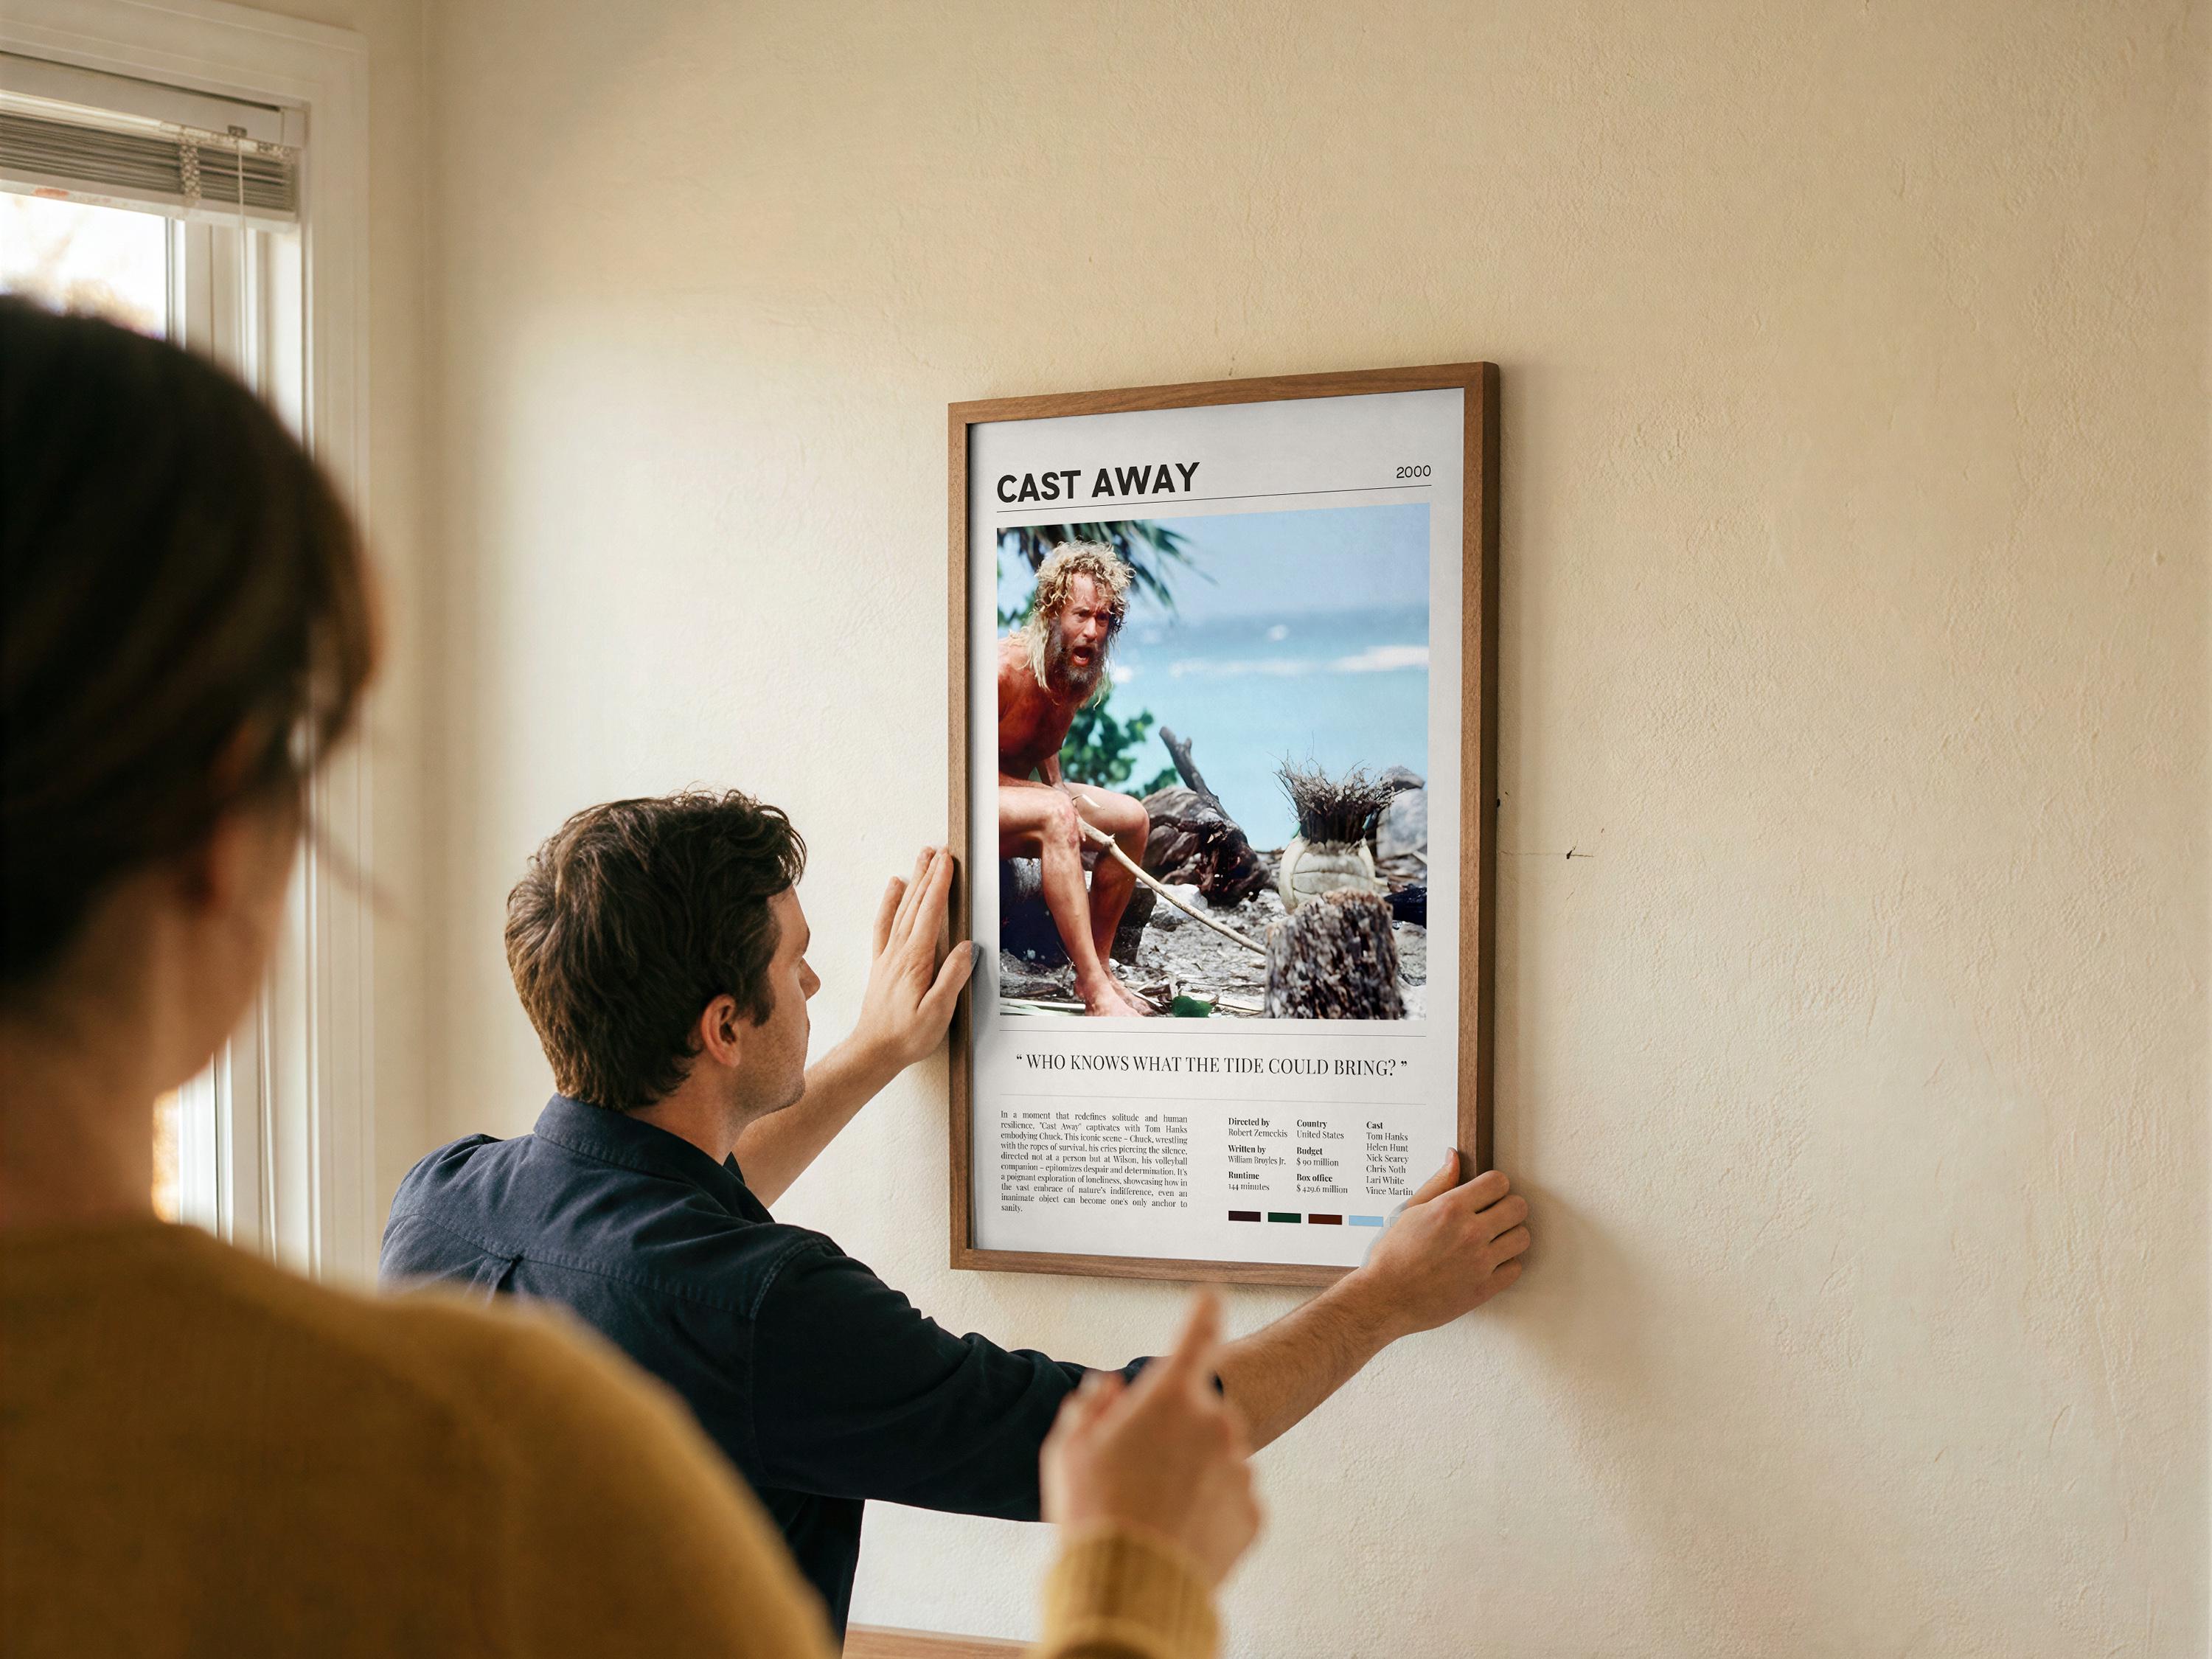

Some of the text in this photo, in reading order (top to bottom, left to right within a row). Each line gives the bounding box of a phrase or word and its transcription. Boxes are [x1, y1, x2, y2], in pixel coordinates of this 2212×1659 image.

[1397, 465, 1431, 479] 2000
[997, 462, 1200, 503] CAST AWAY
[1026, 1054, 1065, 1069] WHO
[1071, 1055, 1129, 1071] KNOWS
[1133, 1057, 1181, 1071] WHAT
[1186, 1057, 1219, 1072] THE
[1224, 1058, 1263, 1073] TIDE
[1269, 1059, 1328, 1074] COULD
[1335, 1060, 1396, 1076] BRING?
[1023, 1112, 1050, 1120] moment
[1056, 1112, 1069, 1120] that
[1075, 1113, 1106, 1121] redefines
[1112, 1113, 1138, 1121] solitude
[1145, 1114, 1158, 1122] and
[1164, 1115, 1187, 1123] human
[1086, 1123, 1120, 1132] captivates
[1124, 1124, 1140, 1132] with
[1144, 1124, 1161, 1133] Tom
[1165, 1125, 1187, 1133] Hanks
[1228, 1118, 1270, 1128] Directed by
[1297, 1119, 1327, 1129] Country
[1366, 1121, 1382, 1130] Cast
[1001, 1131, 1038, 1141] embodying
[1064, 1133, 1079, 1141] This
[1080, 1133, 1101, 1141] iconic
[1155, 1135, 1188, 1145] wrestling
[1228, 1128, 1288, 1138] Robert Zemeckis
[1297, 1130, 1344, 1139] United States
[1366, 1132, 1408, 1141] Tom Hanks
[1001, 1141, 1016, 1150] with
[1017, 1142, 1029, 1150] the
[1089, 1144, 1099, 1152] his
[1100, 1144, 1118, 1152] cries
[1119, 1145, 1147, 1155] piercing
[1149, 1146, 1160, 1154] the
[1228, 1144, 1266, 1155] Written by
[1297, 1147, 1323, 1156] Budget
[1366, 1143, 1409, 1152] Helen Hunt
[1001, 1152, 1029, 1161] directed
[1142, 1156, 1152, 1164] his
[1155, 1157, 1187, 1166] volleyball
[1228, 1155, 1253, 1164] William
[1254, 1156, 1278, 1166] Broyles
[1296, 1157, 1301, 1166] $
[1313, 1158, 1338, 1166] million
[1366, 1154, 1409, 1164] Nick Searcy
[1001, 1163, 1037, 1172] companion
[1046, 1164, 1082, 1173] epitomizes
[1084, 1165, 1109, 1175] despair
[1110, 1166, 1123, 1174] and
[1366, 1165, 1405, 1174] Chris Noth
[1006, 1172, 1036, 1183] poignant
[1037, 1174, 1076, 1183] exploration
[1123, 1176, 1163, 1187] showcasing
[1180, 1178, 1187, 1186] in
[1228, 1171, 1259, 1180] Runtime
[1297, 1174, 1332, 1183] Box office
[1366, 1175, 1404, 1185] Lari White
[1034, 1183, 1062, 1192] embrace
[1241, 1183, 1270, 1191] minutes
[1296, 1184, 1347, 1194] $ 429.6 million
[1366, 1186, 1413, 1195] Vince Martin
[1001, 1193, 1034, 1201] inanimate
[1039, 1194, 1059, 1203] object
[1080, 1196, 1106, 1204] become
[1133, 1198, 1147, 1208] only
[1152, 1198, 1176, 1207] anchor
[1001, 1203, 1023, 1213] sanity.
